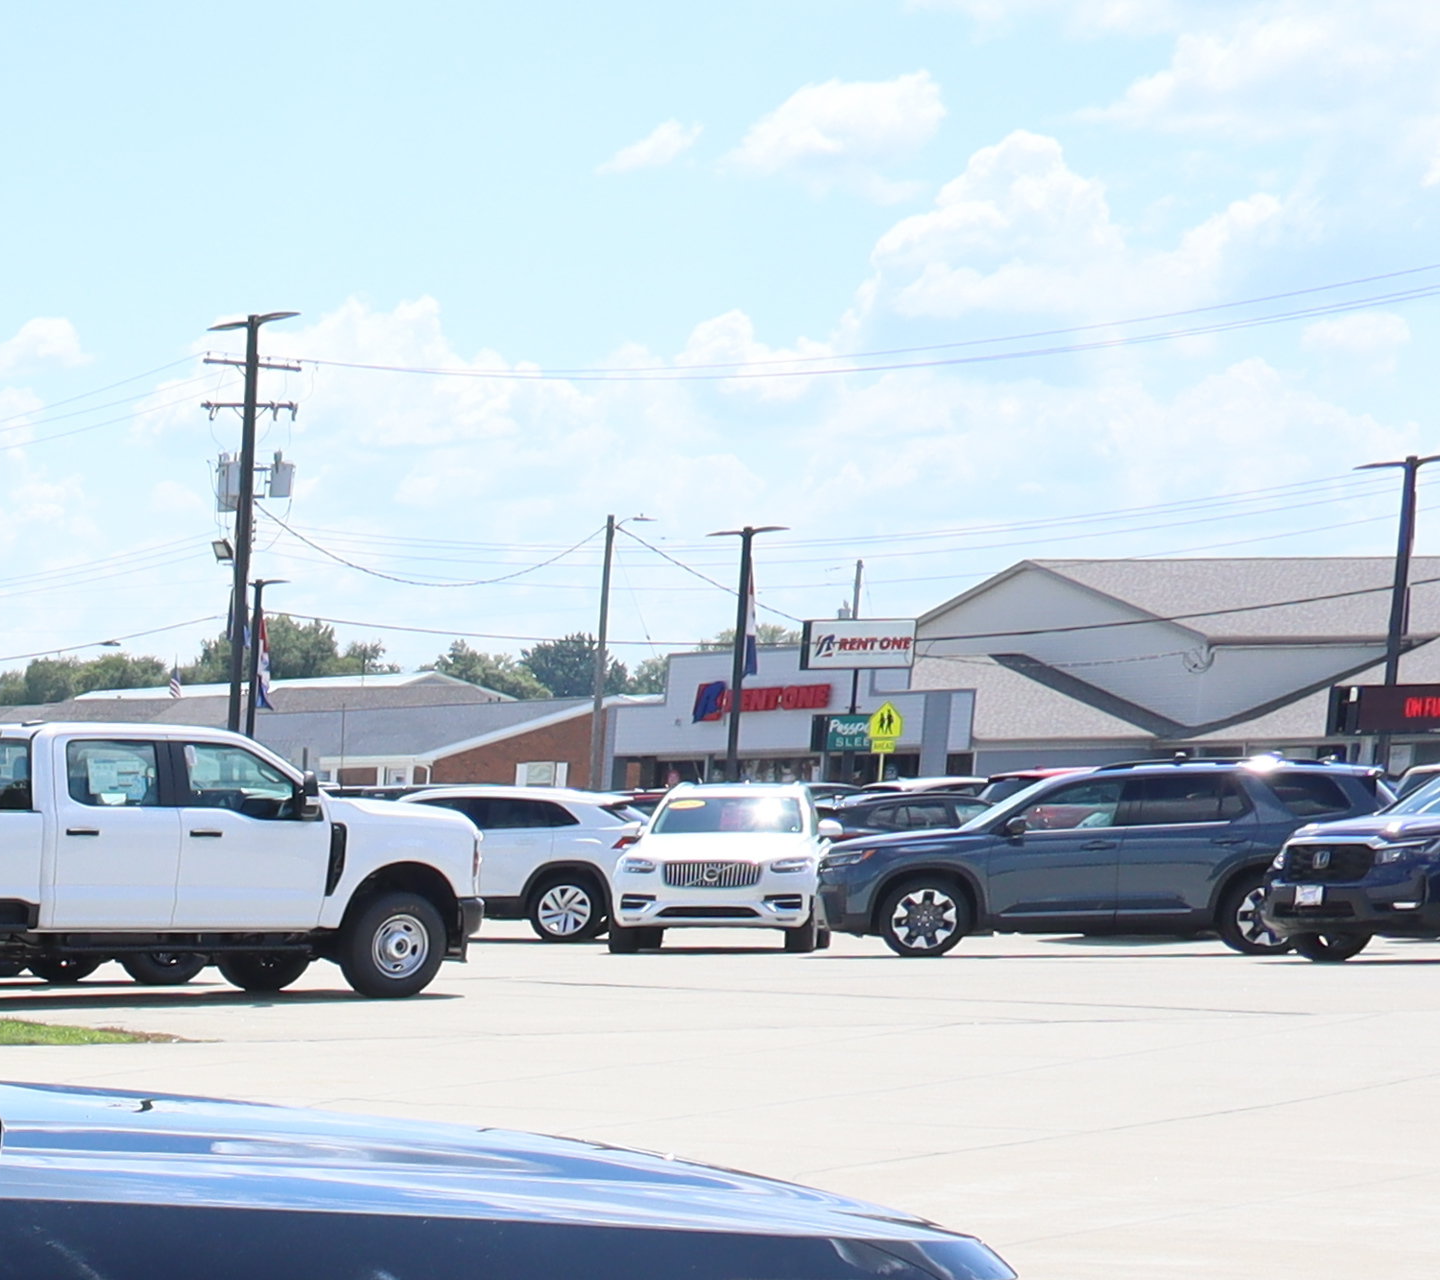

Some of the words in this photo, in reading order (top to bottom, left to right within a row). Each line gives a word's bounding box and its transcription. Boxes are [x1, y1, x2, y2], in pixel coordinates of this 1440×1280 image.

[838, 638, 878, 651] RENT
[879, 636, 913, 650] ONE
[781, 684, 831, 710] ONE
